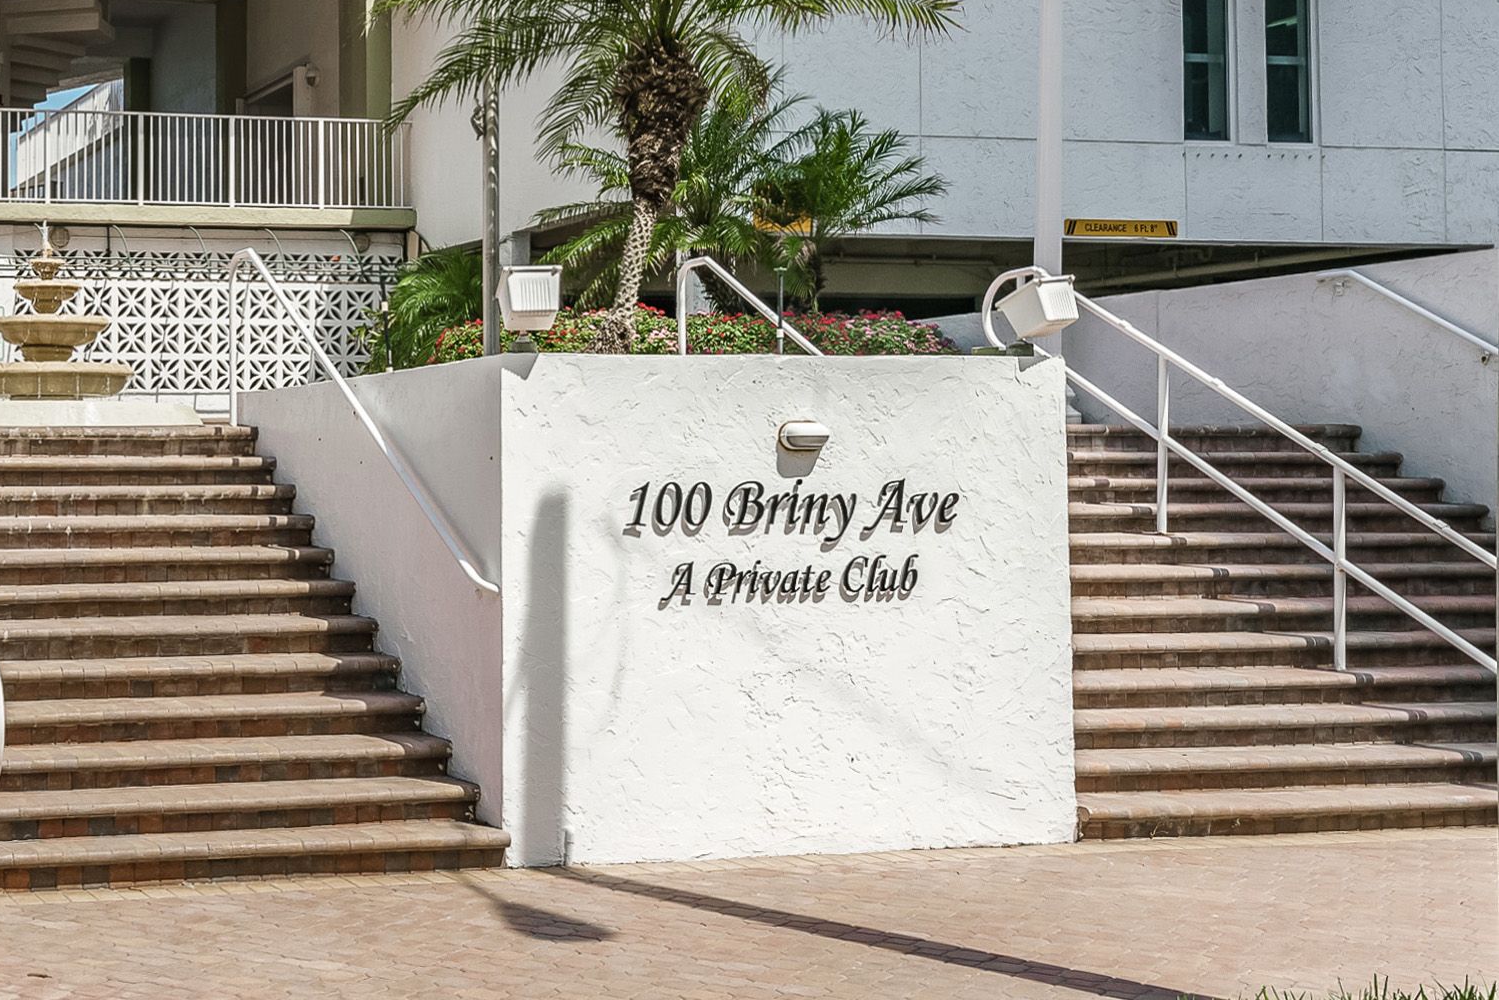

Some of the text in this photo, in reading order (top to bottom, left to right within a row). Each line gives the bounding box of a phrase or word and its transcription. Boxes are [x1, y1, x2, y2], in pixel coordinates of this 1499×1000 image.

[1084, 223, 1127, 233] CLEARANCE
[1134, 225, 1139, 233] 6
[625, 478, 960, 542] 100 Briny Ave
[660, 554, 919, 601] A Private Club
